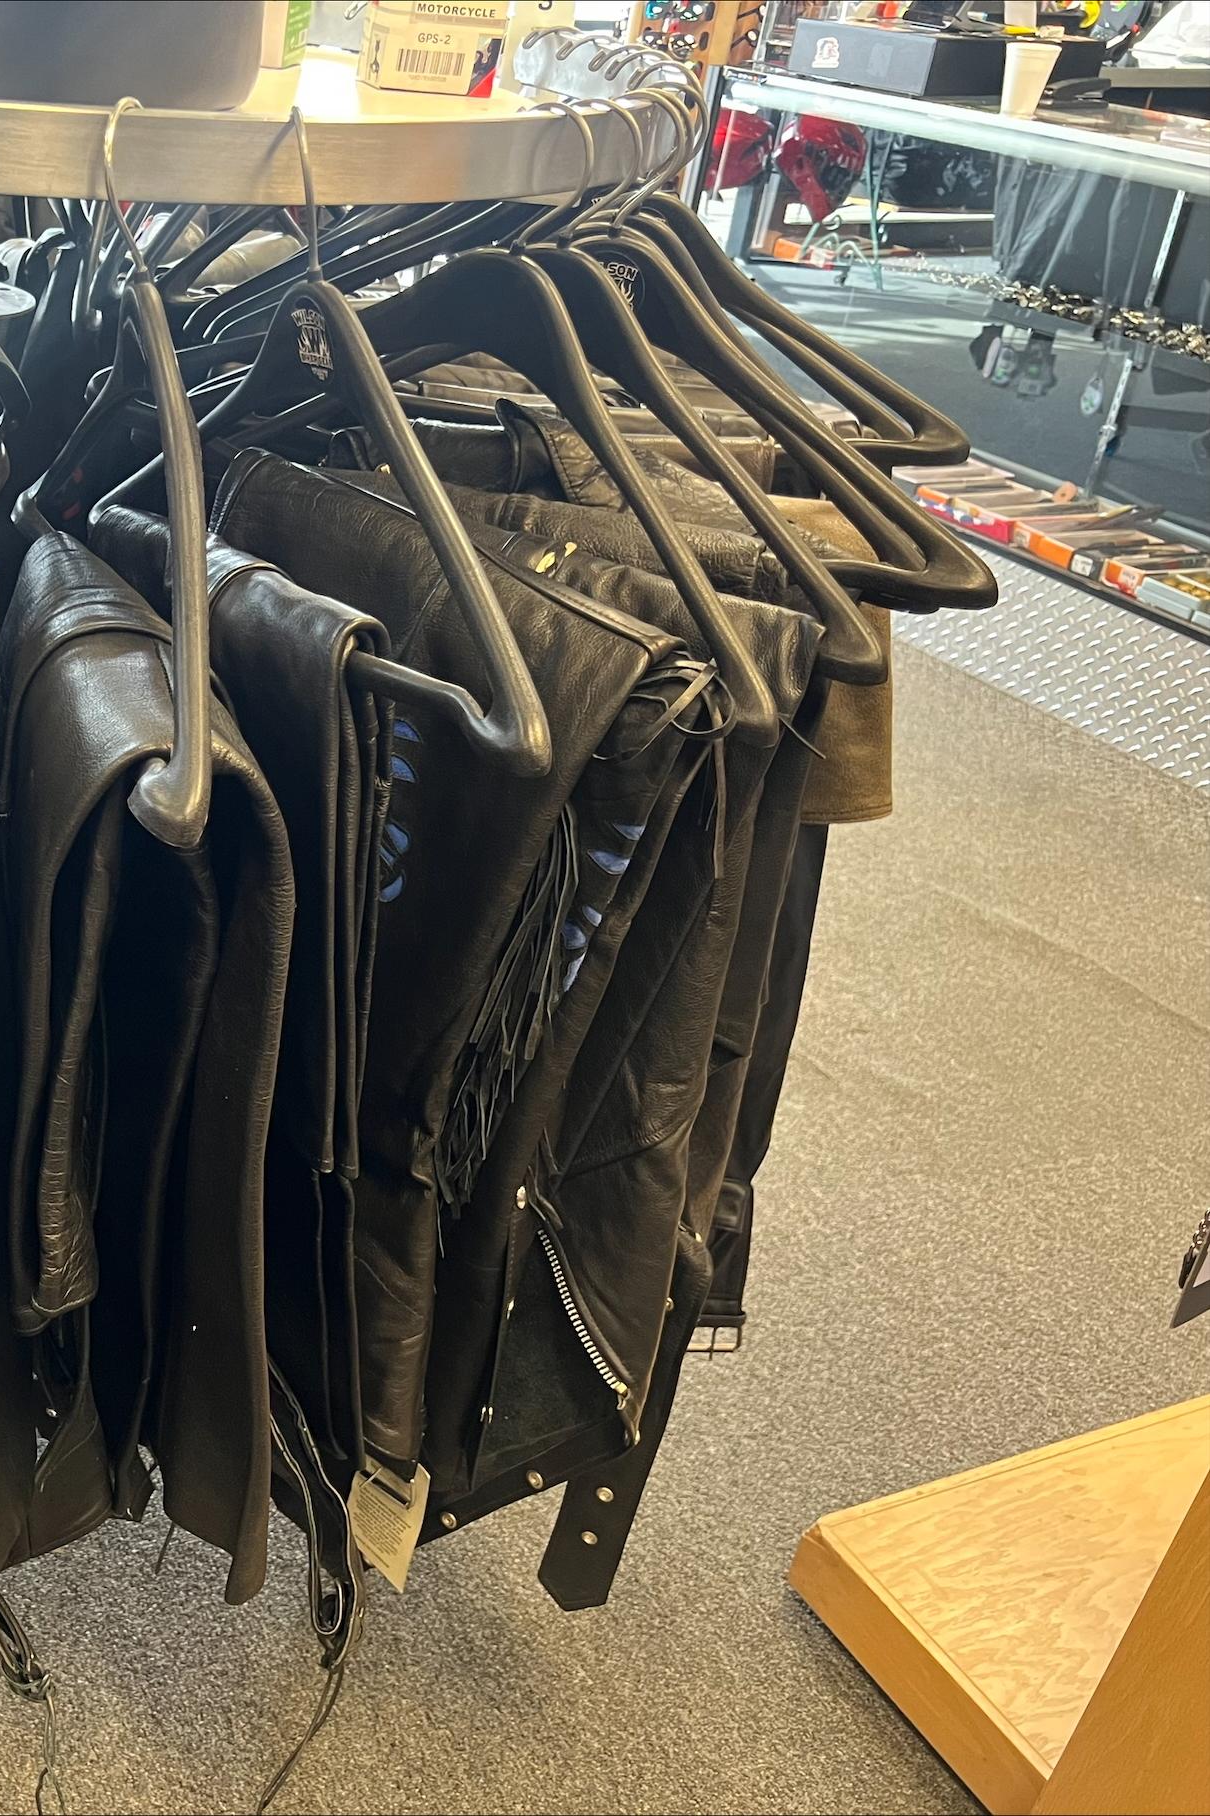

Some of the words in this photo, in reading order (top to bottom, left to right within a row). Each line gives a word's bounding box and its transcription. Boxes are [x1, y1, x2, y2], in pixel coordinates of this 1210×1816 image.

[416, 3, 496, 18] MOTORCYCLE
[417, 32, 451, 45] GPS-2
[599, 262, 639, 281] SON
